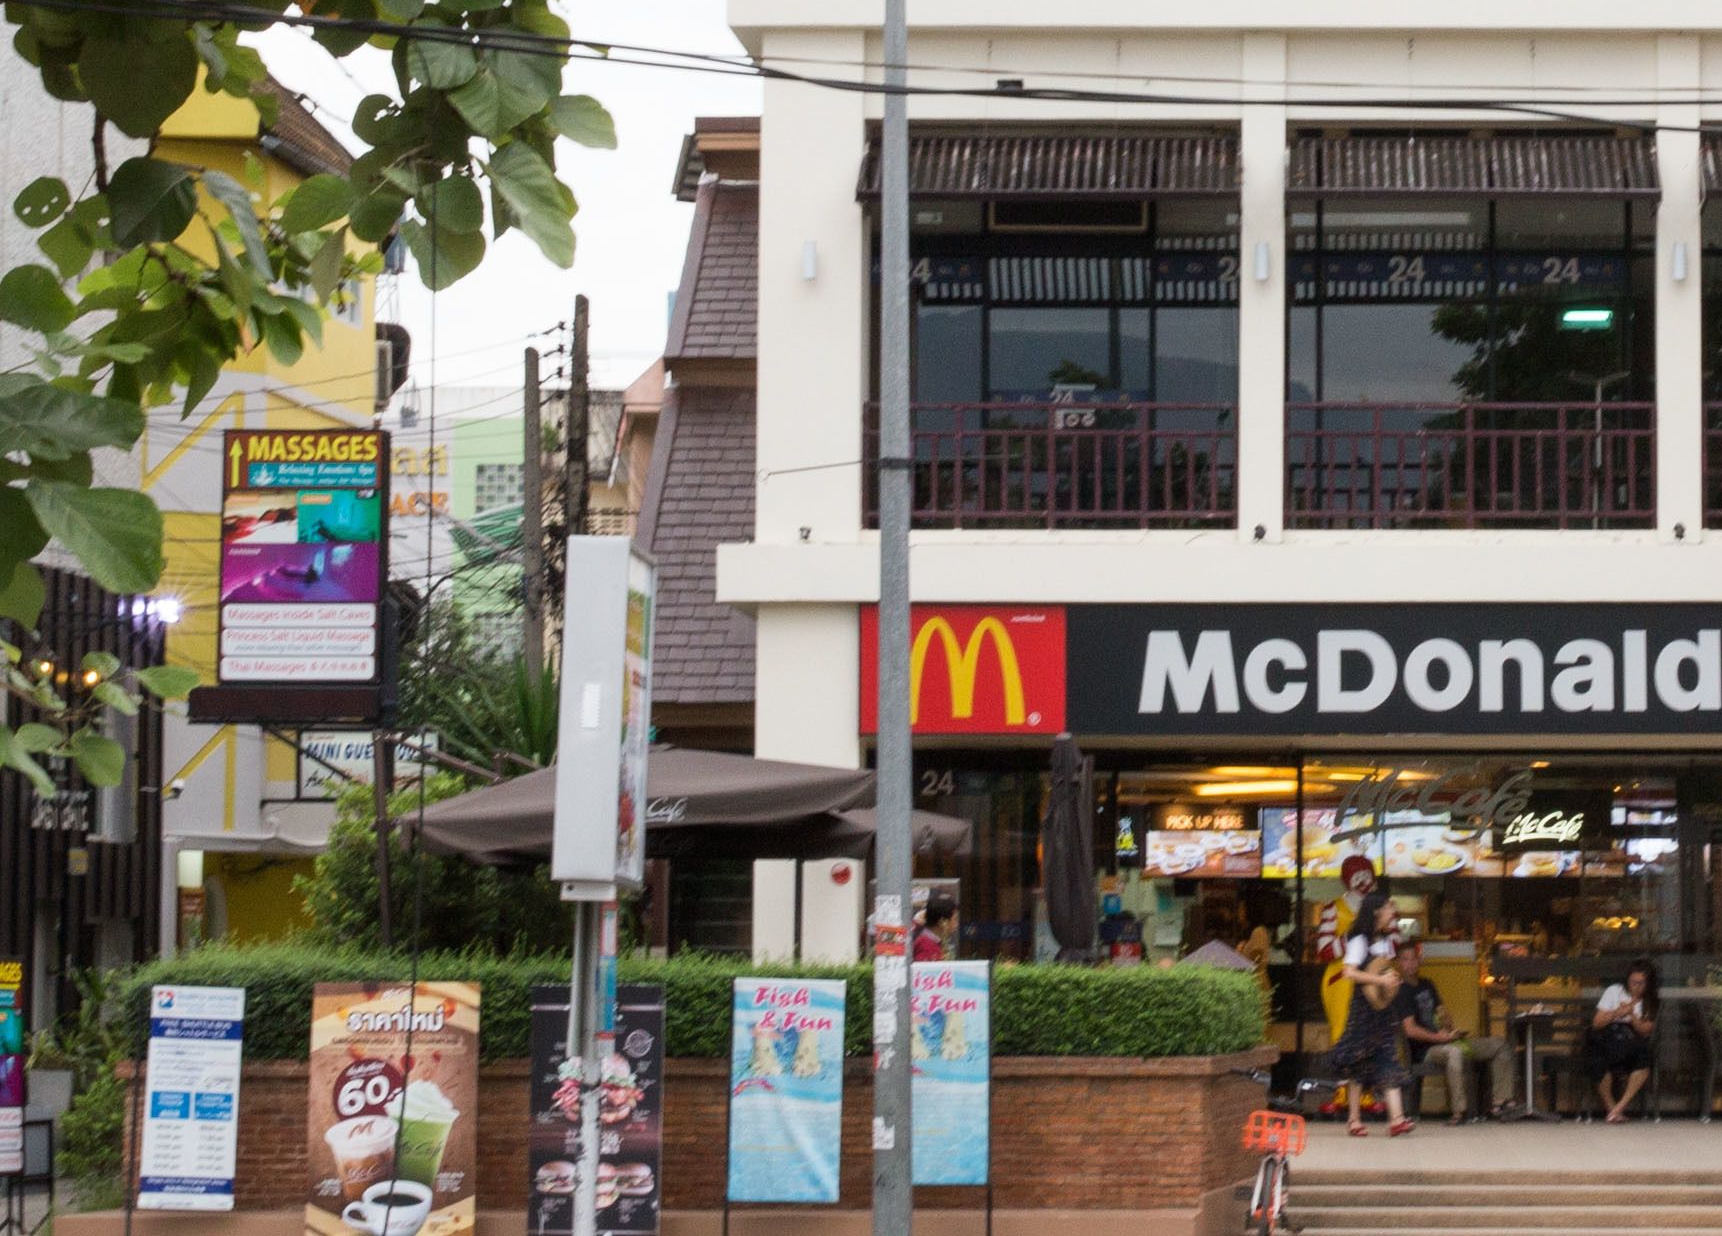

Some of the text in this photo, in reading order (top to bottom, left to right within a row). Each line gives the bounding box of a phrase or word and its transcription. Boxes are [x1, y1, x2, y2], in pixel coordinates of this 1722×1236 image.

[1387, 255, 1427, 283] 24
[1543, 256, 1583, 284] 24
[247, 435, 379, 461] MASSAGES
[921, 769, 954, 796] 24
[1502, 810, 1585, 845] McCafé
[754, 986, 809, 1007] Fish
[928, 994, 978, 1013] Fun
[782, 1012, 833, 1031] Fun
